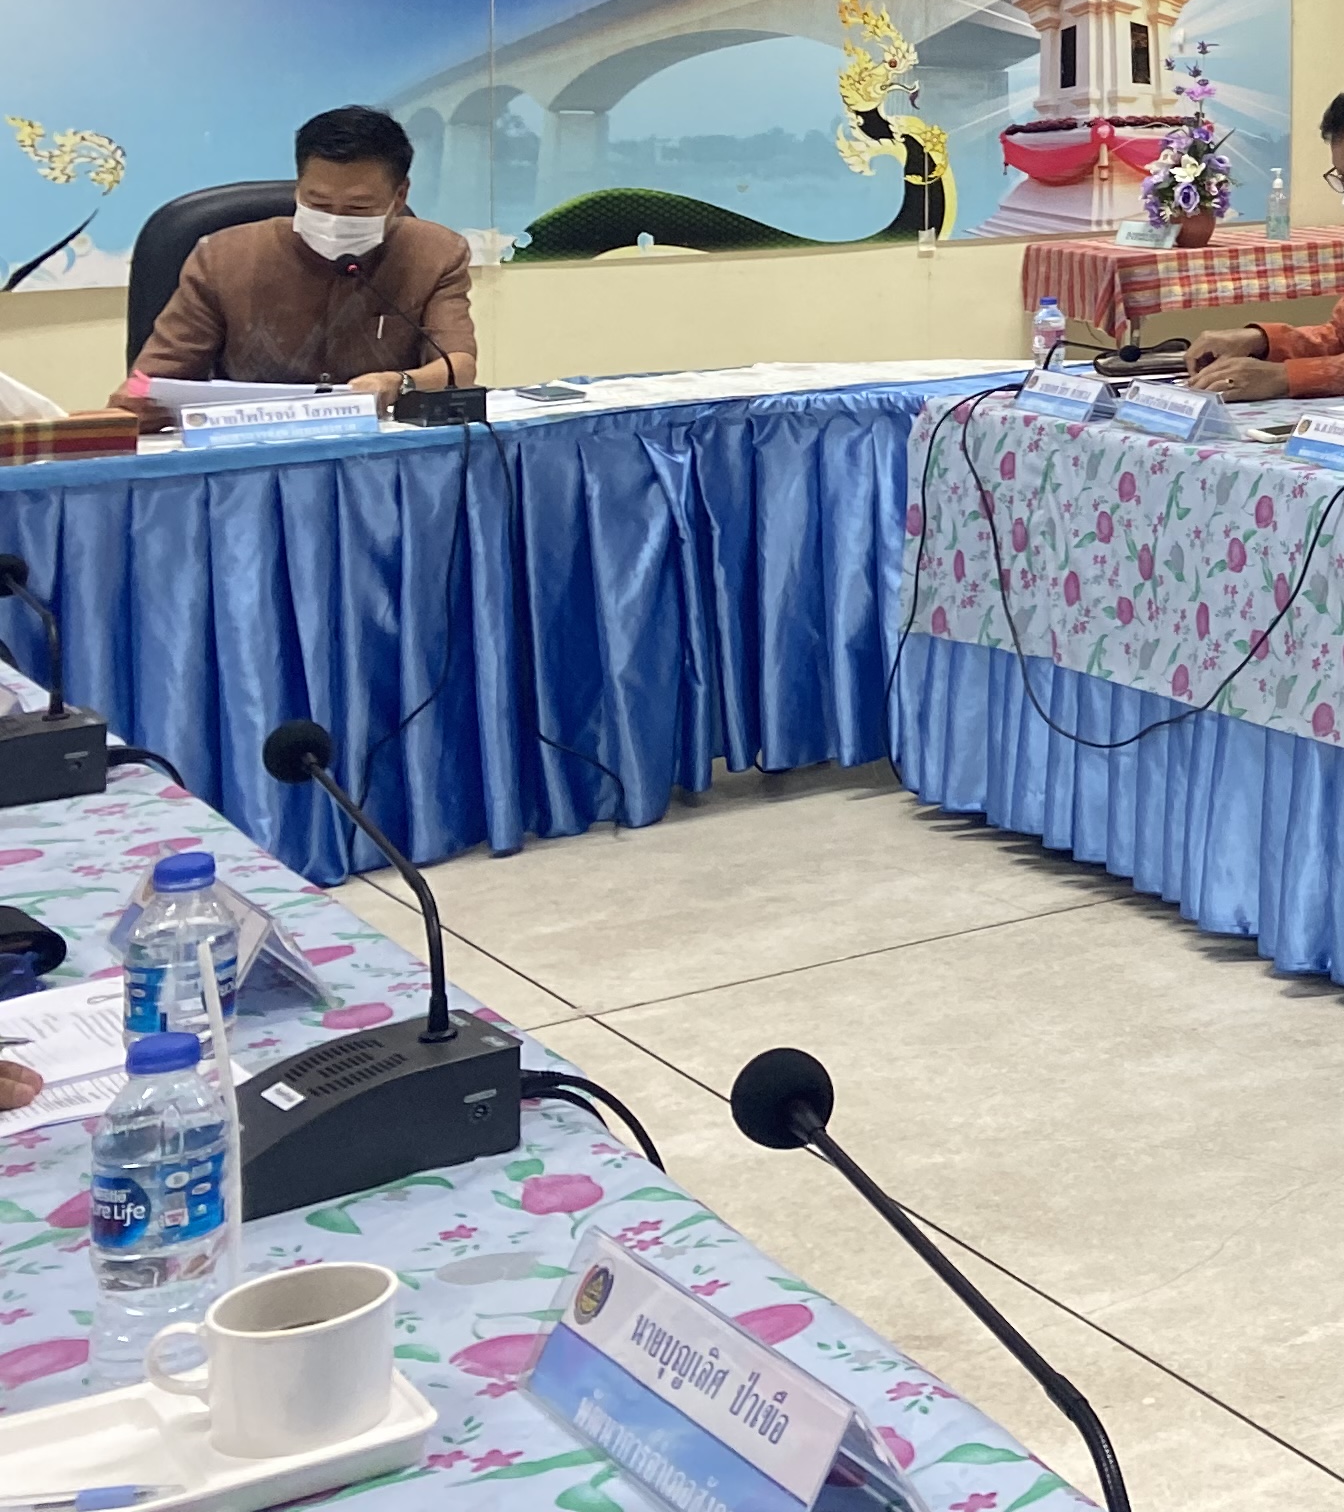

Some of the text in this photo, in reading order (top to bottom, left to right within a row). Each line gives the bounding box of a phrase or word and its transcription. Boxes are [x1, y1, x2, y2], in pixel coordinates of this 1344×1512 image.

[113, 1202, 146, 1227] Life
[630, 1313, 731, 1400] นายบุญเลิศ
